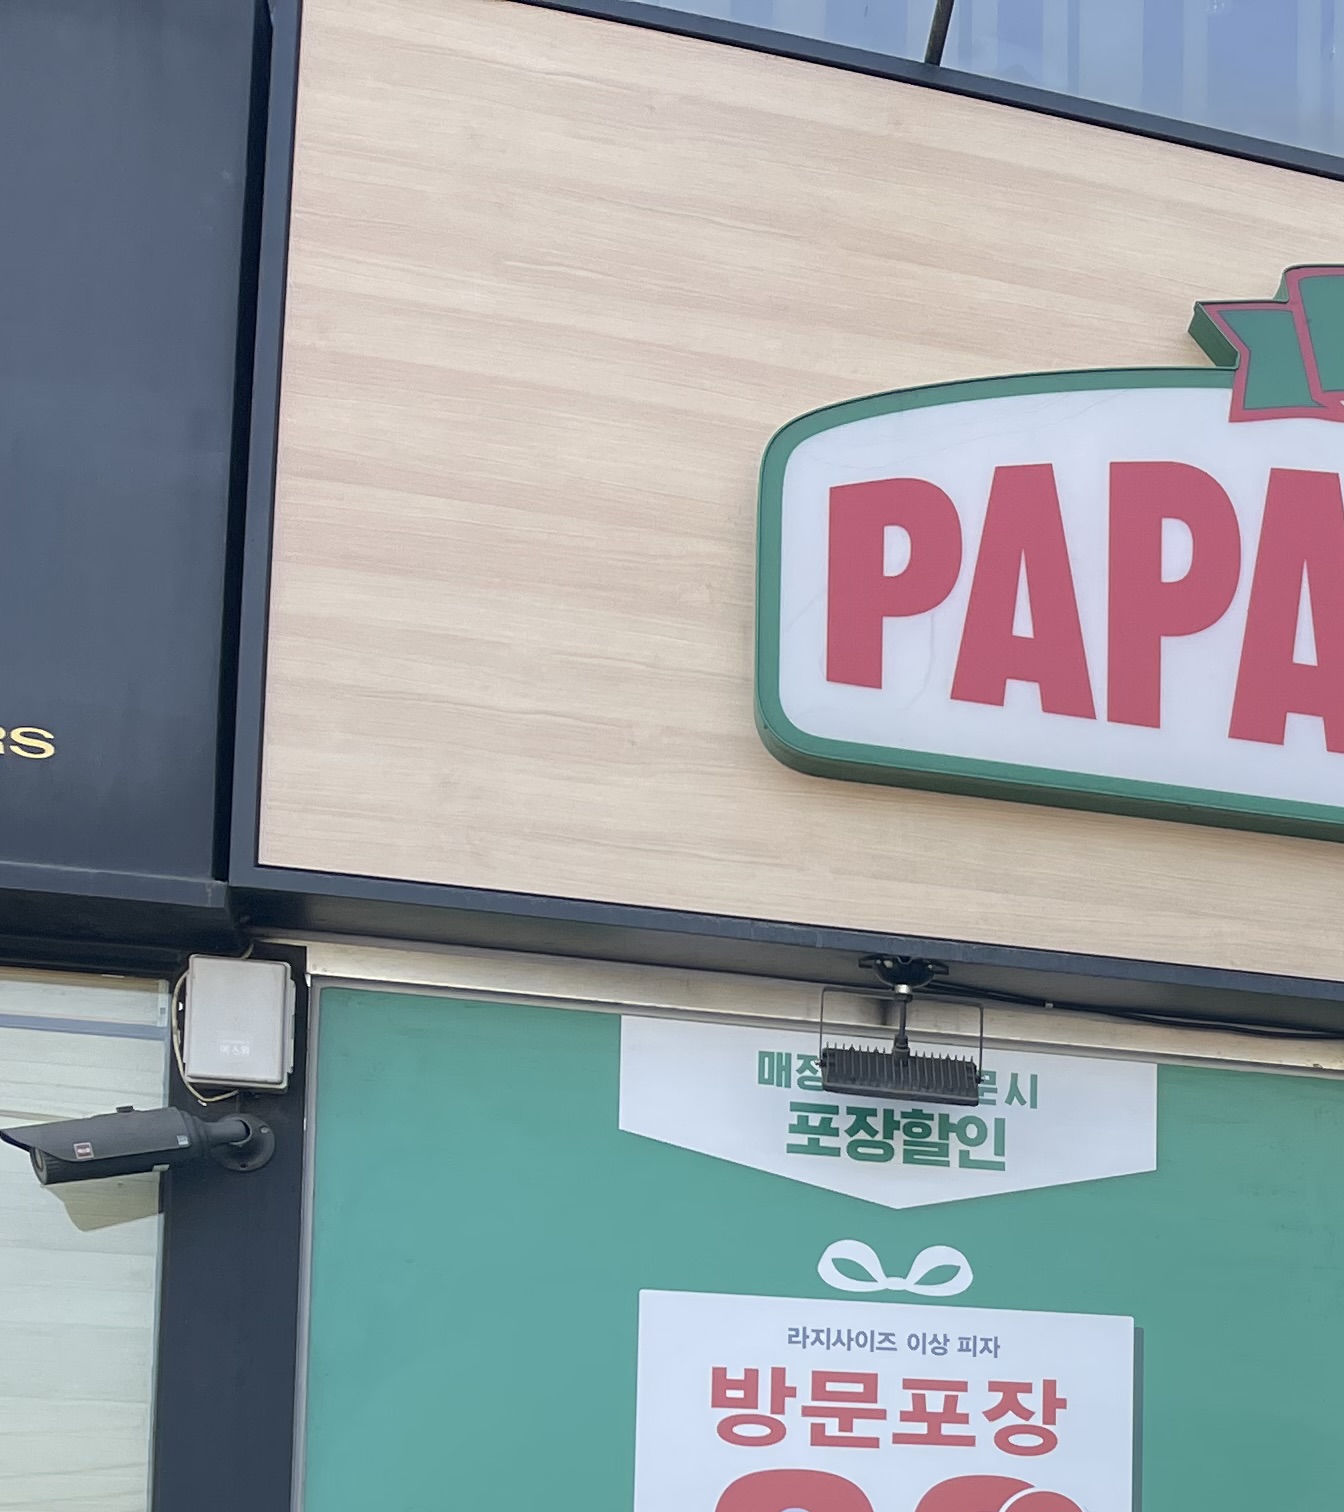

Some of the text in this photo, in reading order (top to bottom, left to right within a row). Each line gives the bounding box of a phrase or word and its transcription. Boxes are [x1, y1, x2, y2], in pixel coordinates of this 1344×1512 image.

[785, 1100, 1007, 1172] 포장할인
[786, 1326, 1001, 1360] 라지사이즈 이상 피자
[709, 1364, 1068, 1458] 방문포장
